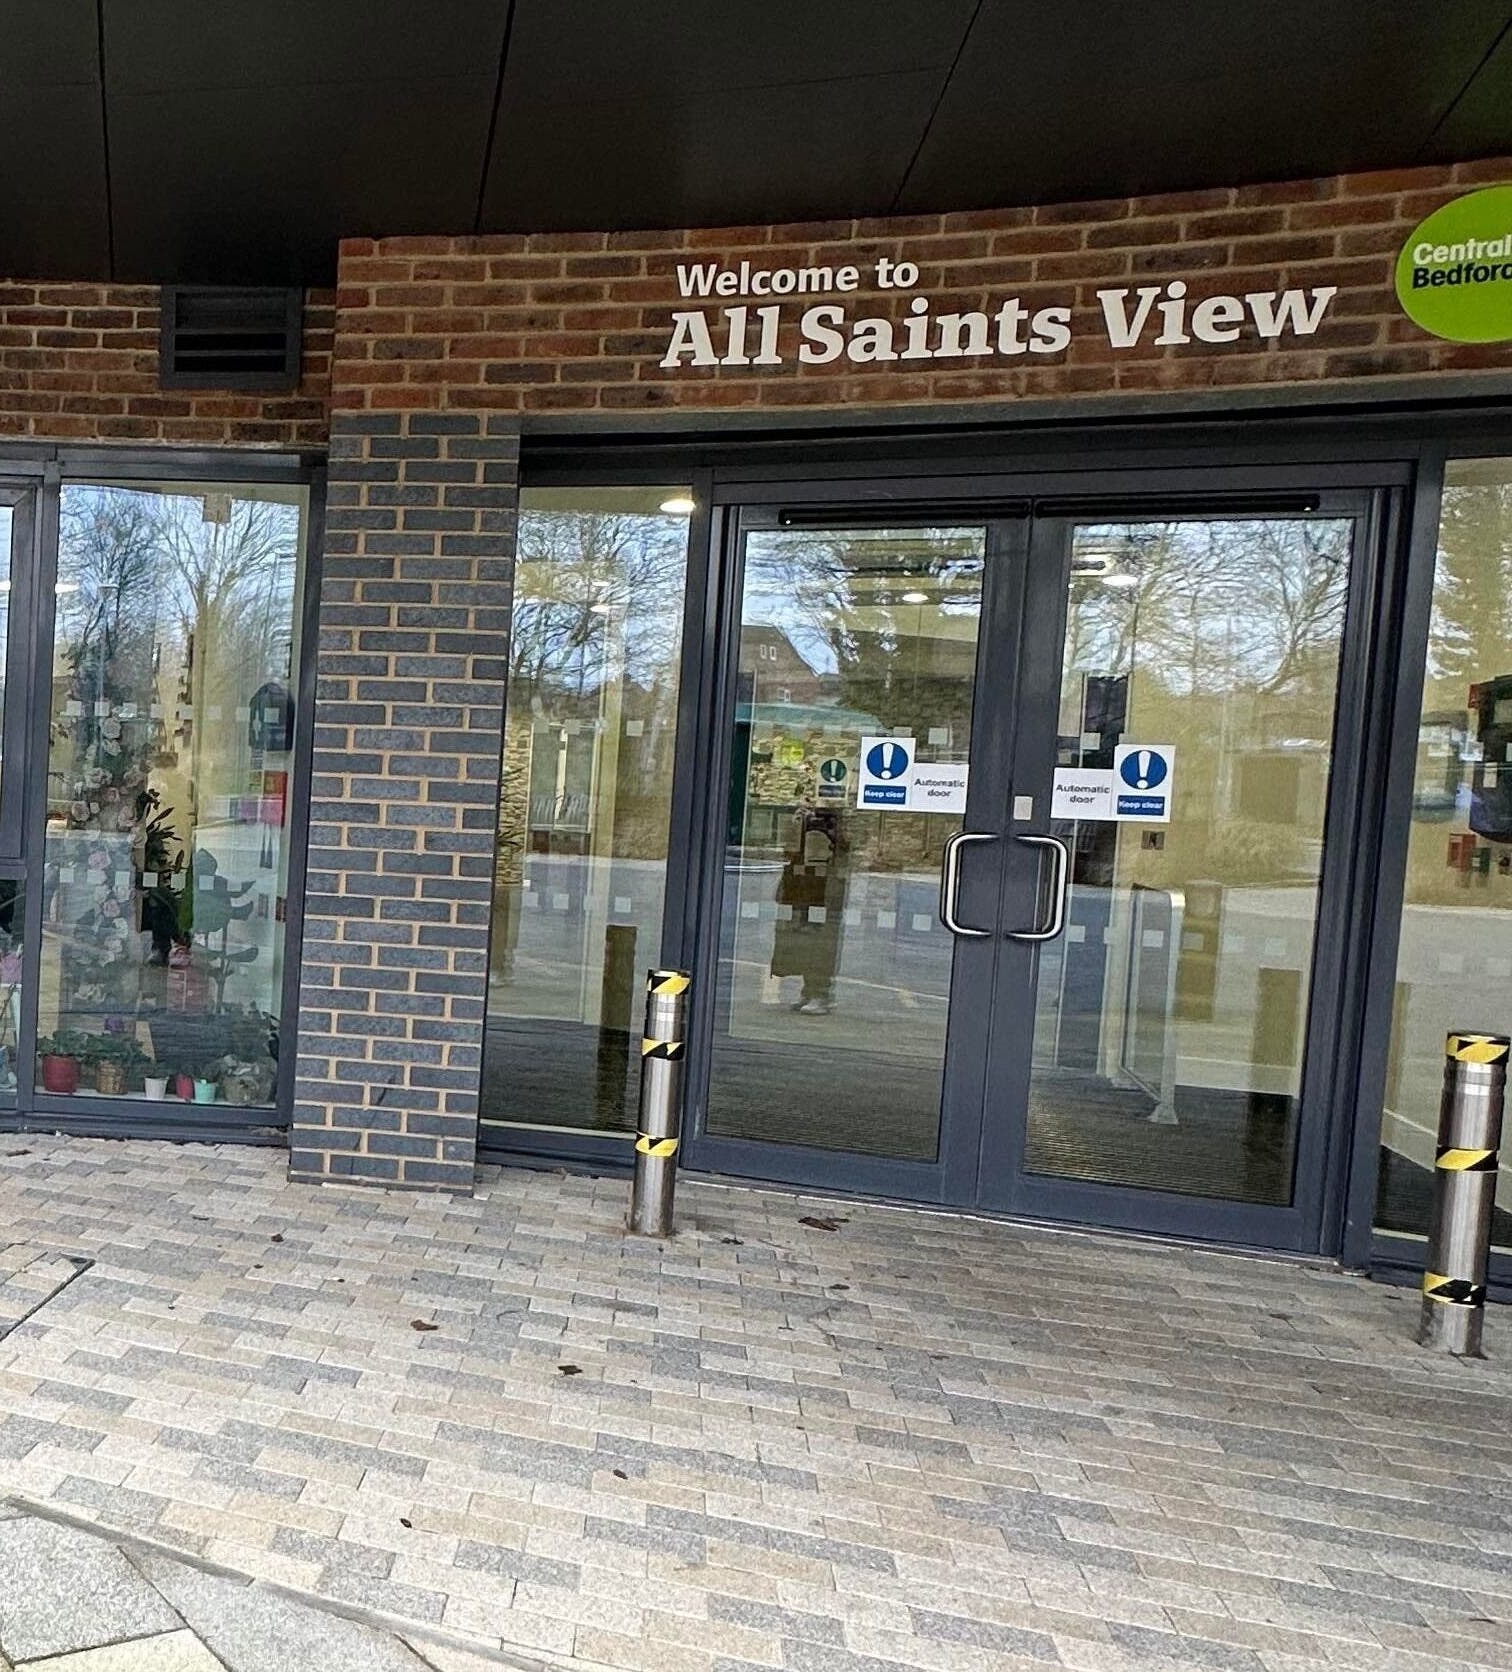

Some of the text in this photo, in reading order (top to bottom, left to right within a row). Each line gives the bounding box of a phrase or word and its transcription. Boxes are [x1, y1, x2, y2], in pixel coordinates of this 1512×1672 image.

[1412, 234, 1512, 265] Central
[676, 257, 919, 298] Welcome to
[659, 281, 1338, 368] All Saints View
[914, 778, 965, 788] Automatic
[865, 789, 905, 798] Keep clear
[928, 789, 951, 797] door
[1056, 784, 1110, 794] Automatic
[1069, 795, 1096, 803] door
[1118, 800, 1164, 809] Keep clear
